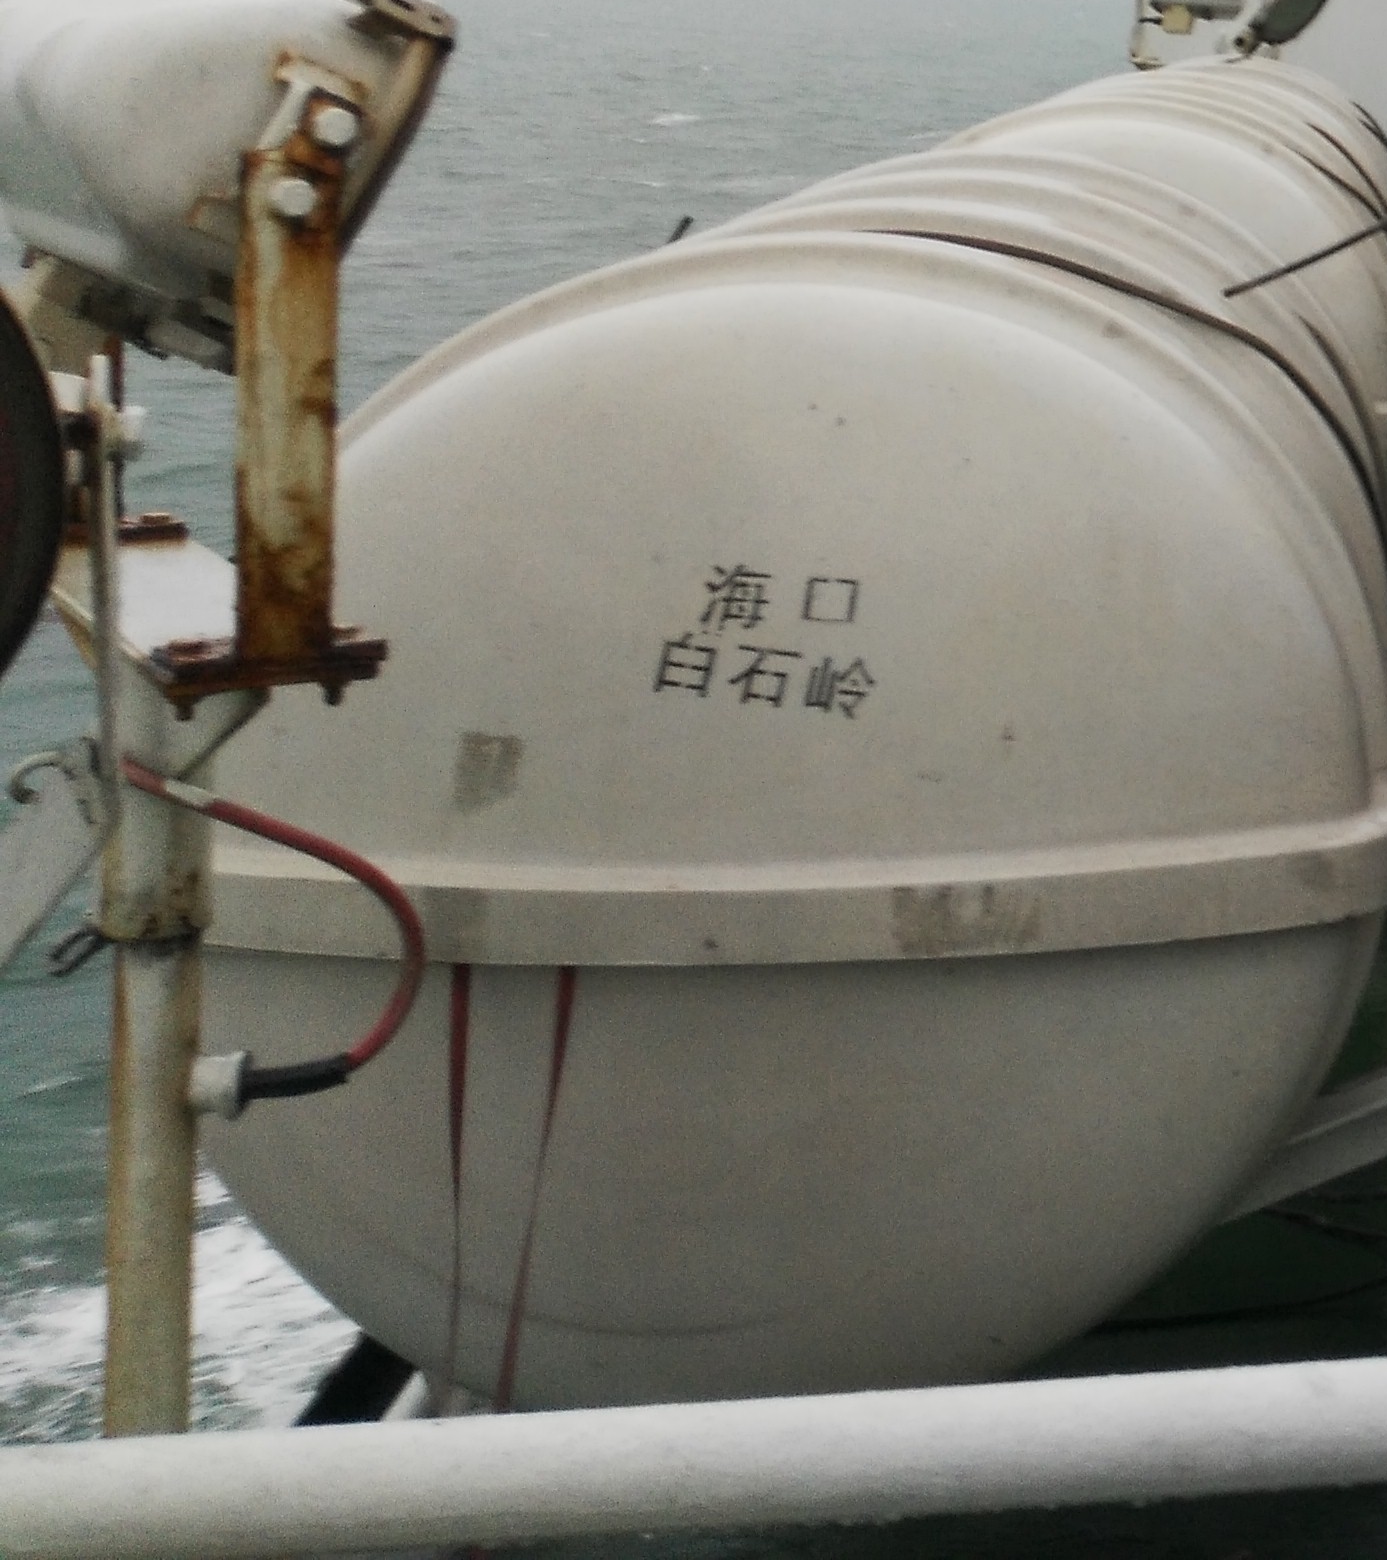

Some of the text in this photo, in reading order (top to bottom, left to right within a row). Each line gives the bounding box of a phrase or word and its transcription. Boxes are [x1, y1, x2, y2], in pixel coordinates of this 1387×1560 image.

[700, 563, 859, 630] 海口
[653, 632, 876, 720] 白石岭
